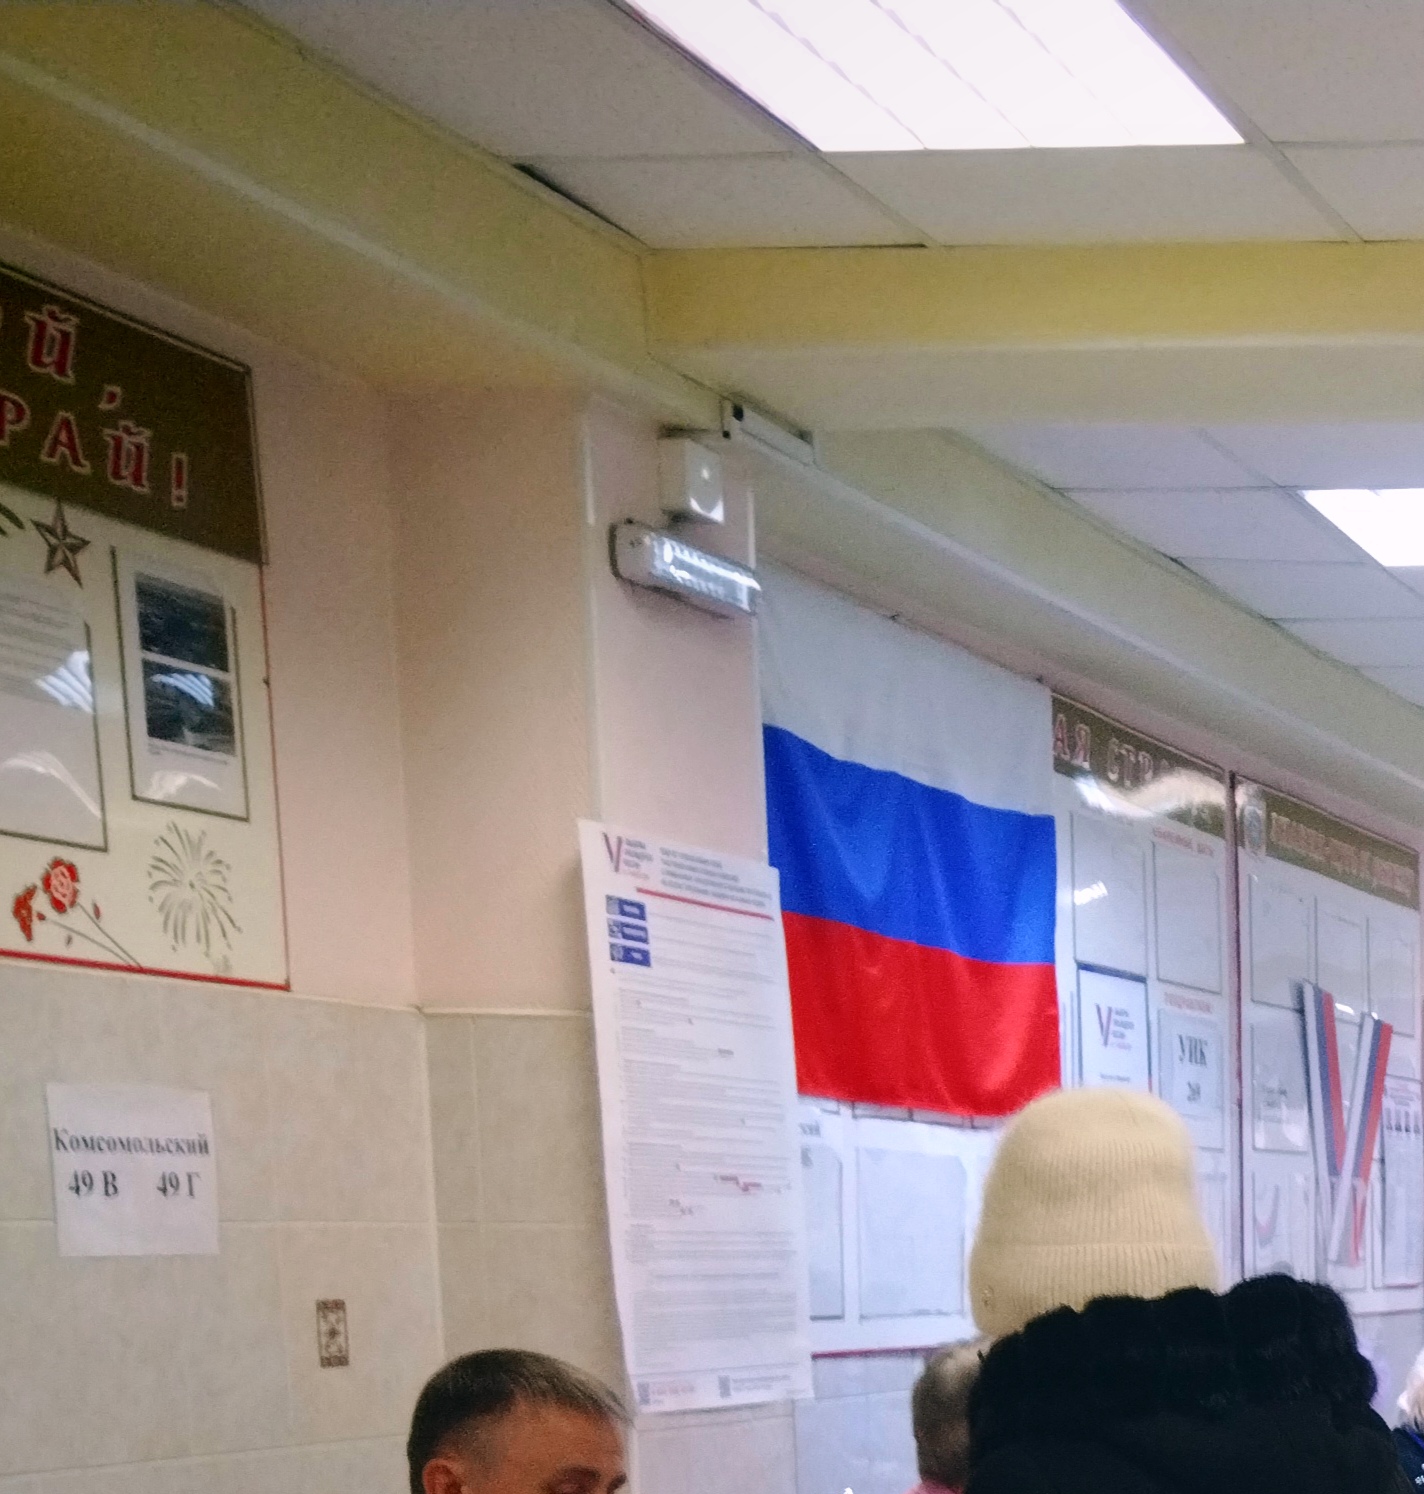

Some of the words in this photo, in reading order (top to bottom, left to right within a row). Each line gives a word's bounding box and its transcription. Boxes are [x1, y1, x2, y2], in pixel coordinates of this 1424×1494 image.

[53, 1127, 209, 1155] Комсомольский
[69, 1169, 94, 1197] 49
[157, 1171, 180, 1197] 49
